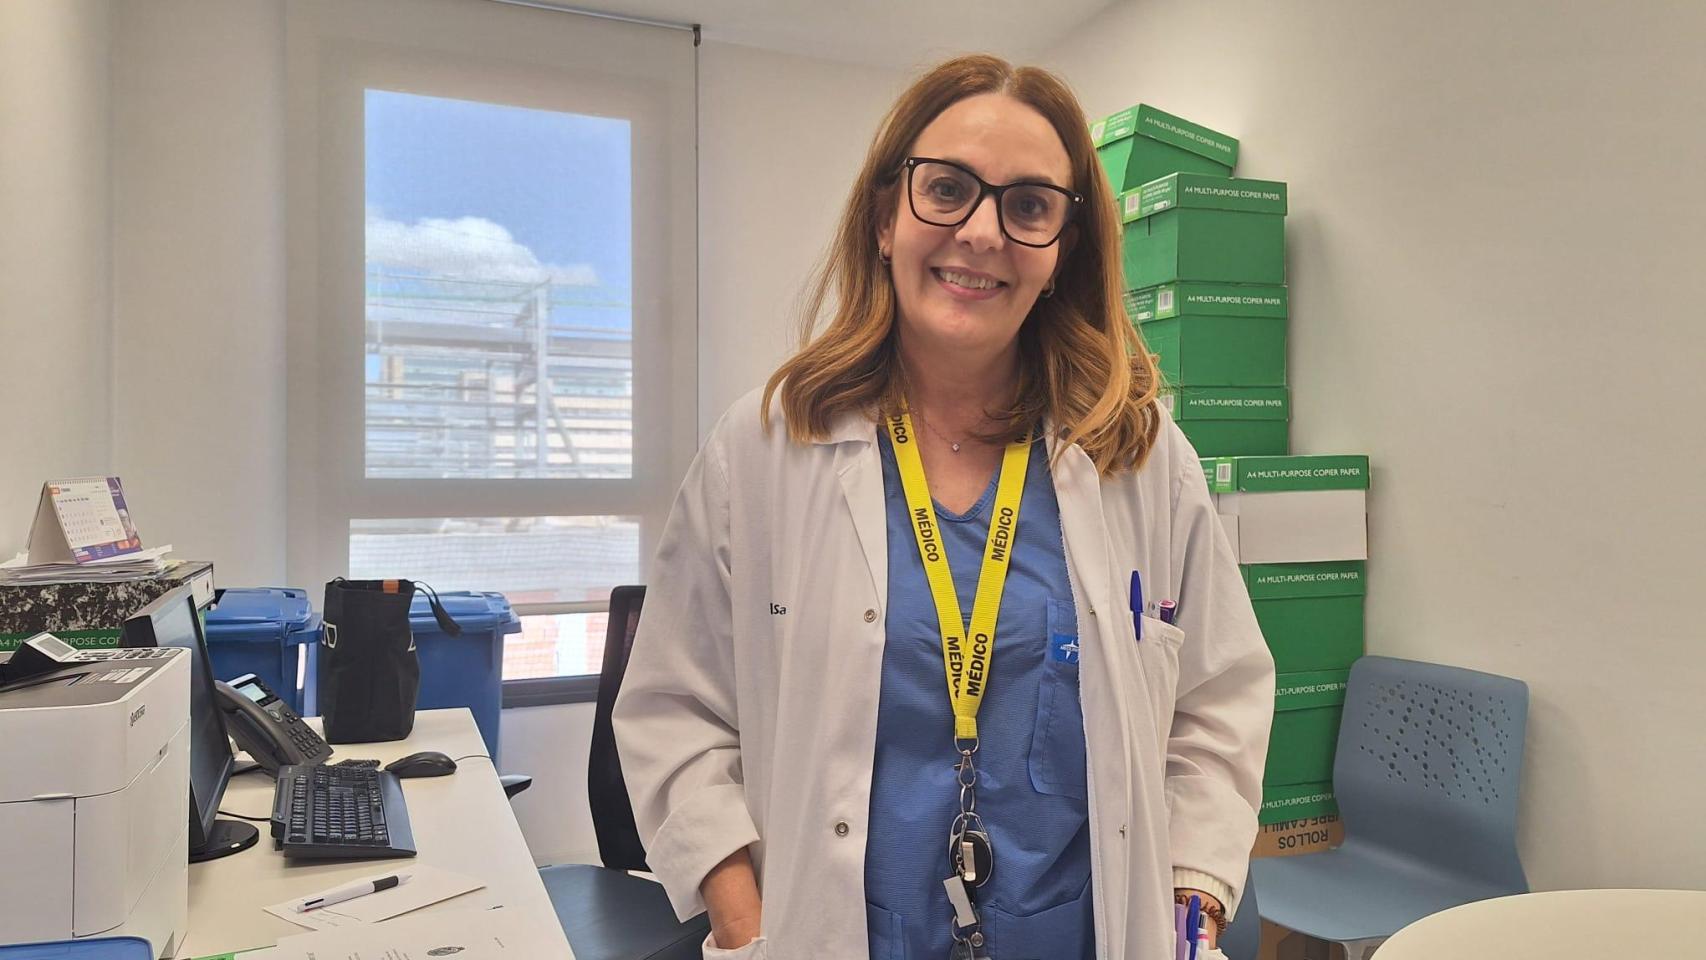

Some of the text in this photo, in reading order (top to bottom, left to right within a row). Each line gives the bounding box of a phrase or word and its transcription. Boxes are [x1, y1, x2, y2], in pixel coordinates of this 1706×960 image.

[1154, 120, 1195, 140] MULTI-PURPOSE
[1195, 135, 1215, 146] COPIER
[1215, 142, 1231, 153] PAPER
[1194, 186, 1240, 197] MULTI-PURPOSE
[1240, 190, 1262, 199] COPIER
[1262, 192, 1280, 200] PAPER
[1196, 295, 1242, 304] MULTI-PURPOSE
[1242, 296, 1263, 305] COPIER
[1198, 399, 1242, 407] MULTI-PURPOSE
[1243, 399, 1265, 407] COPIER
[891, 415, 908, 443] DICO
[1246, 467, 1361, 479] A4 MULTI-PURPOSE COPIER PAPER
[914, 507, 940, 562] MÉDICO
[991, 507, 1014, 562] MÉDICO
[1266, 574, 1315, 584] MULTI-PURPOSE
[1316, 572, 1339, 581] COPIER
[1340, 571, 1359, 580] PAPER
[966, 633, 988, 696] MÉDICO
[1273, 686, 1315, 696] ULTI-PURPOSE
[1316, 683, 1338, 692] COPIER
[1266, 795, 1311, 809] MULTI-PURPOSE
[1278, 829, 1328, 849] ROLLOS
